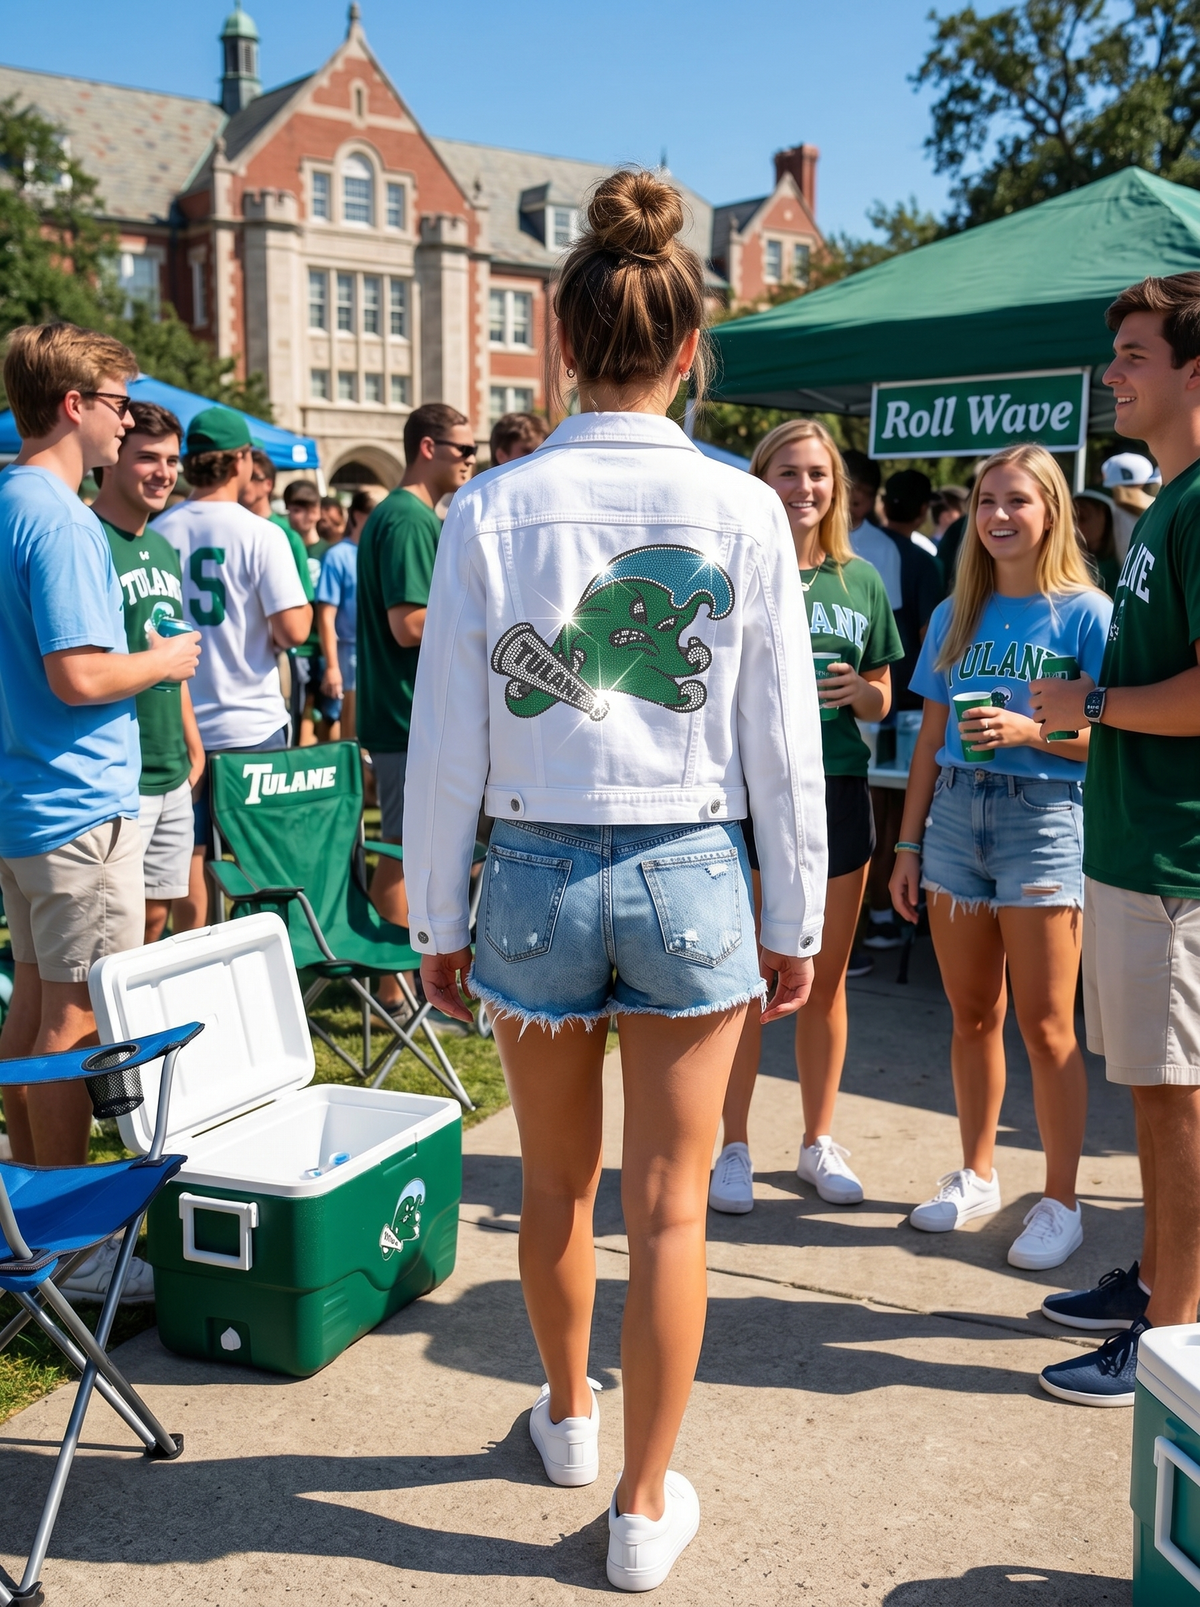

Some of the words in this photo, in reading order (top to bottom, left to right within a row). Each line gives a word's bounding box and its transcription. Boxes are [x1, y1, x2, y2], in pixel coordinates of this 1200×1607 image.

[881, 396, 957, 439] Roll
[967, 393, 1074, 435] Wave
[947, 640, 1059, 689] ULAN
[242, 763, 337, 805] TULANE
